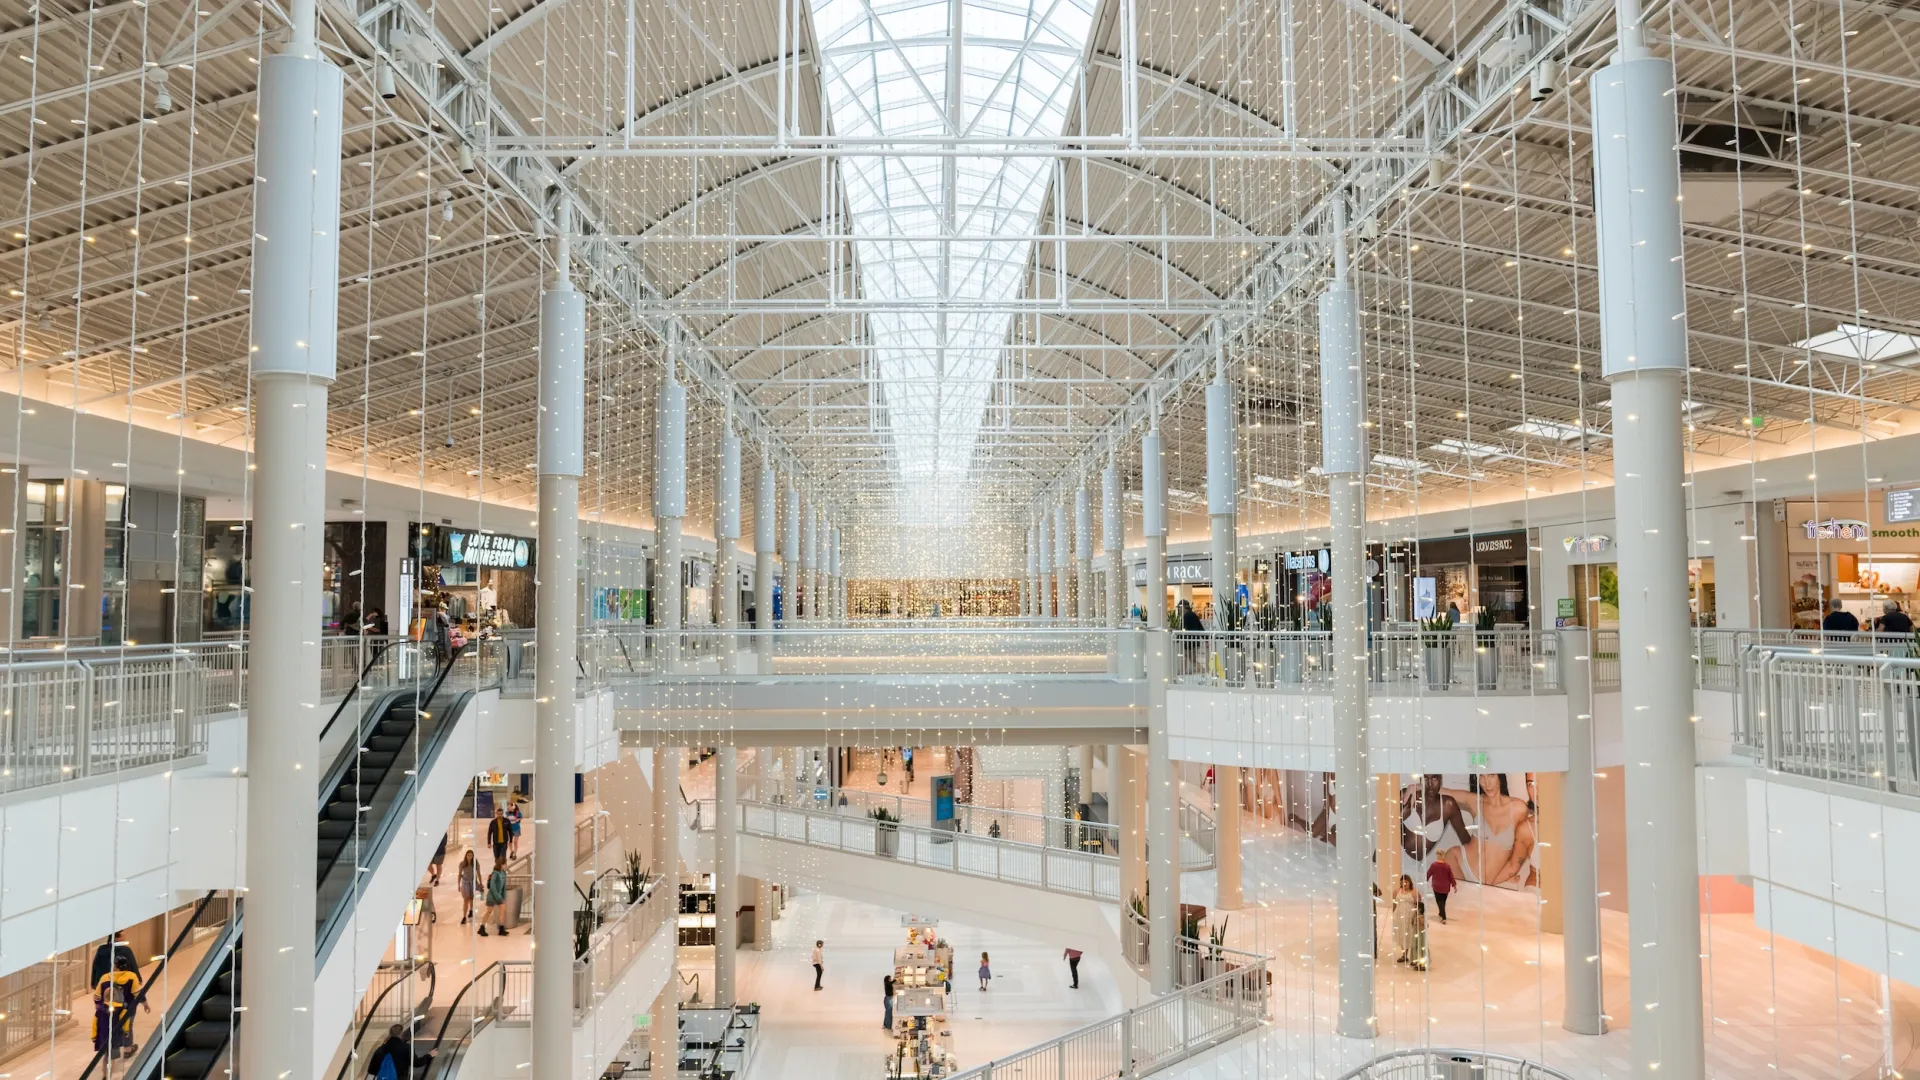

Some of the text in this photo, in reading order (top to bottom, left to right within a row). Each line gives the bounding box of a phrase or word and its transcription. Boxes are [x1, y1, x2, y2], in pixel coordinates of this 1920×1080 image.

[468, 534, 515, 551] LOVE FROM
[463, 546, 515, 568] MINNESOTA
